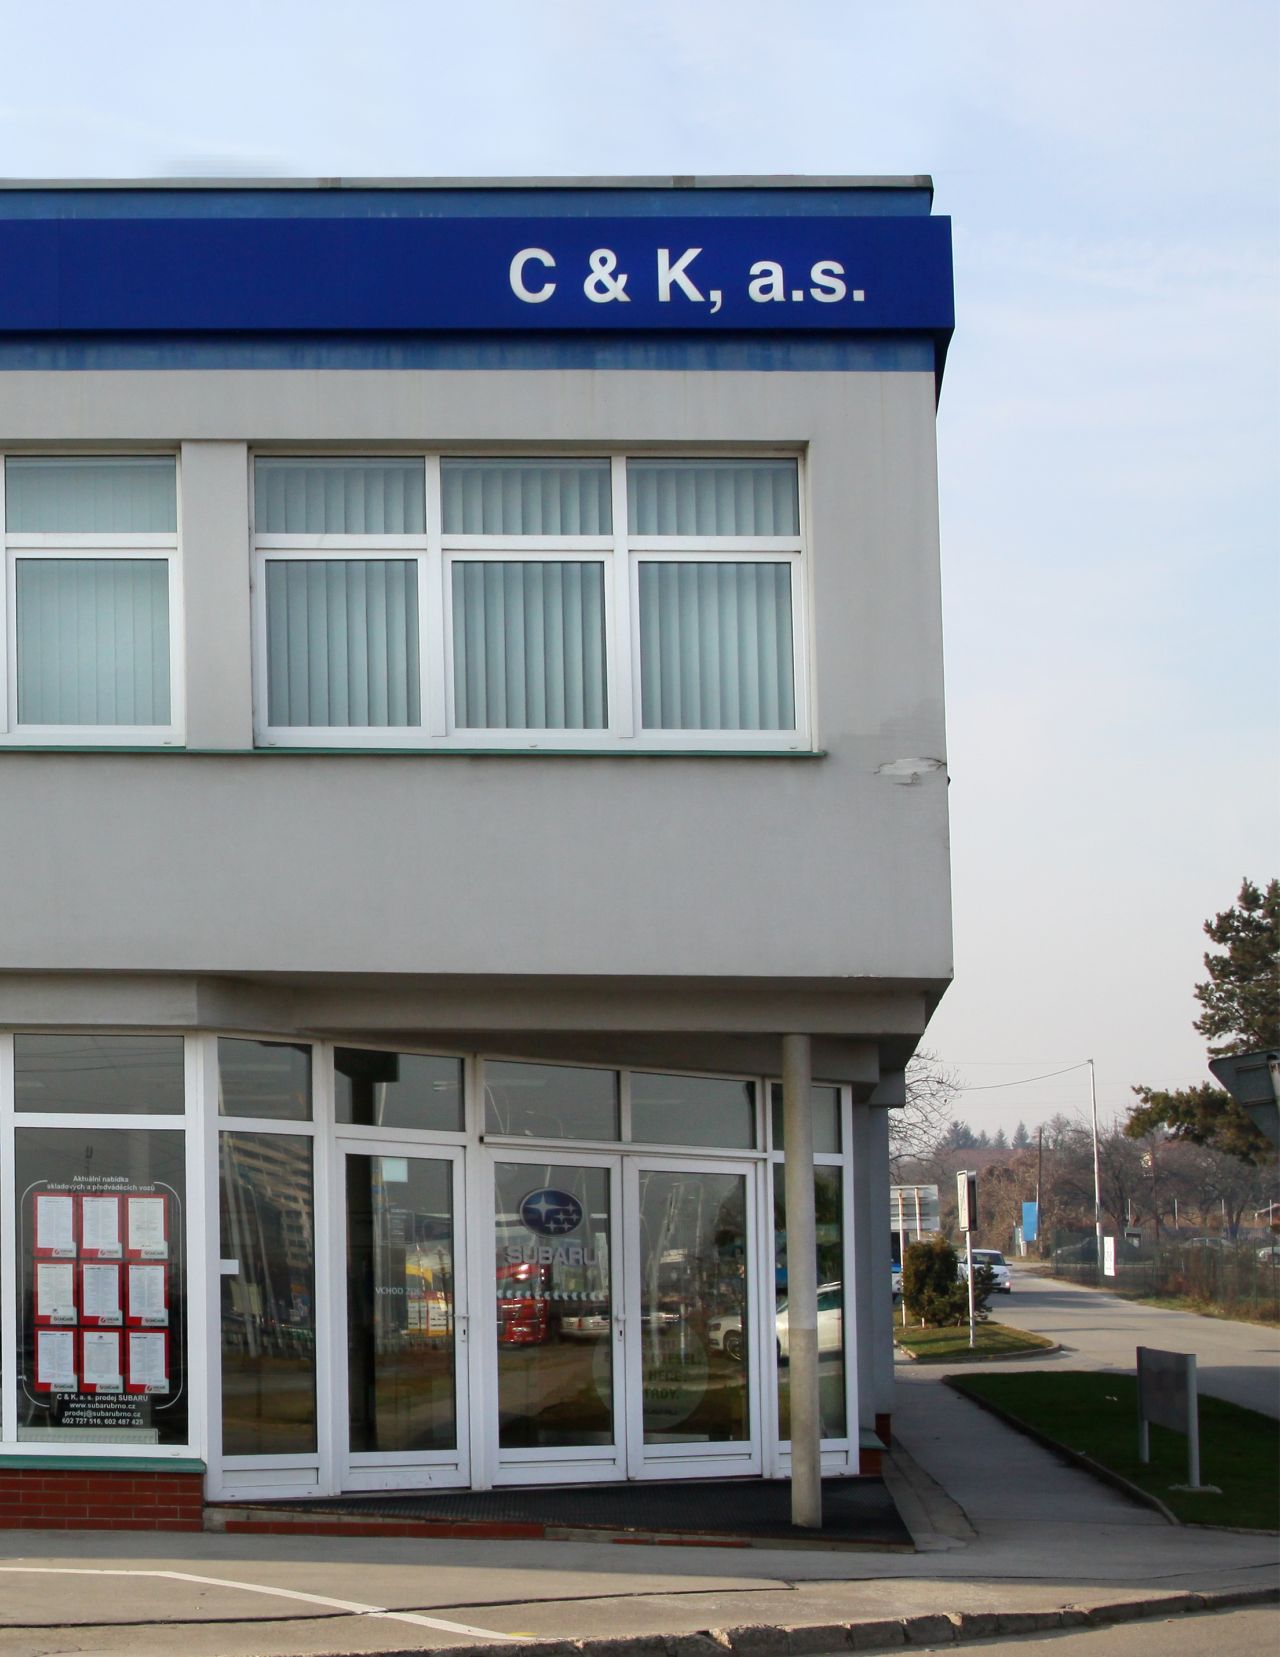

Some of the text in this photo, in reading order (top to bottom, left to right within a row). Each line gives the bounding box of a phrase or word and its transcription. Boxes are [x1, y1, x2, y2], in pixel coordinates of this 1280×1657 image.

[509, 247, 866, 314] C & K, a.s.
[505, 1246, 599, 1265] SUBARU
[375, 1287, 404, 1295] VCHOD
[95, 1394, 117, 1402] prodej
[118, 1394, 148, 1402] SUBARU
[64, 1410, 141, 1418] prodej@subarubrno.cz
